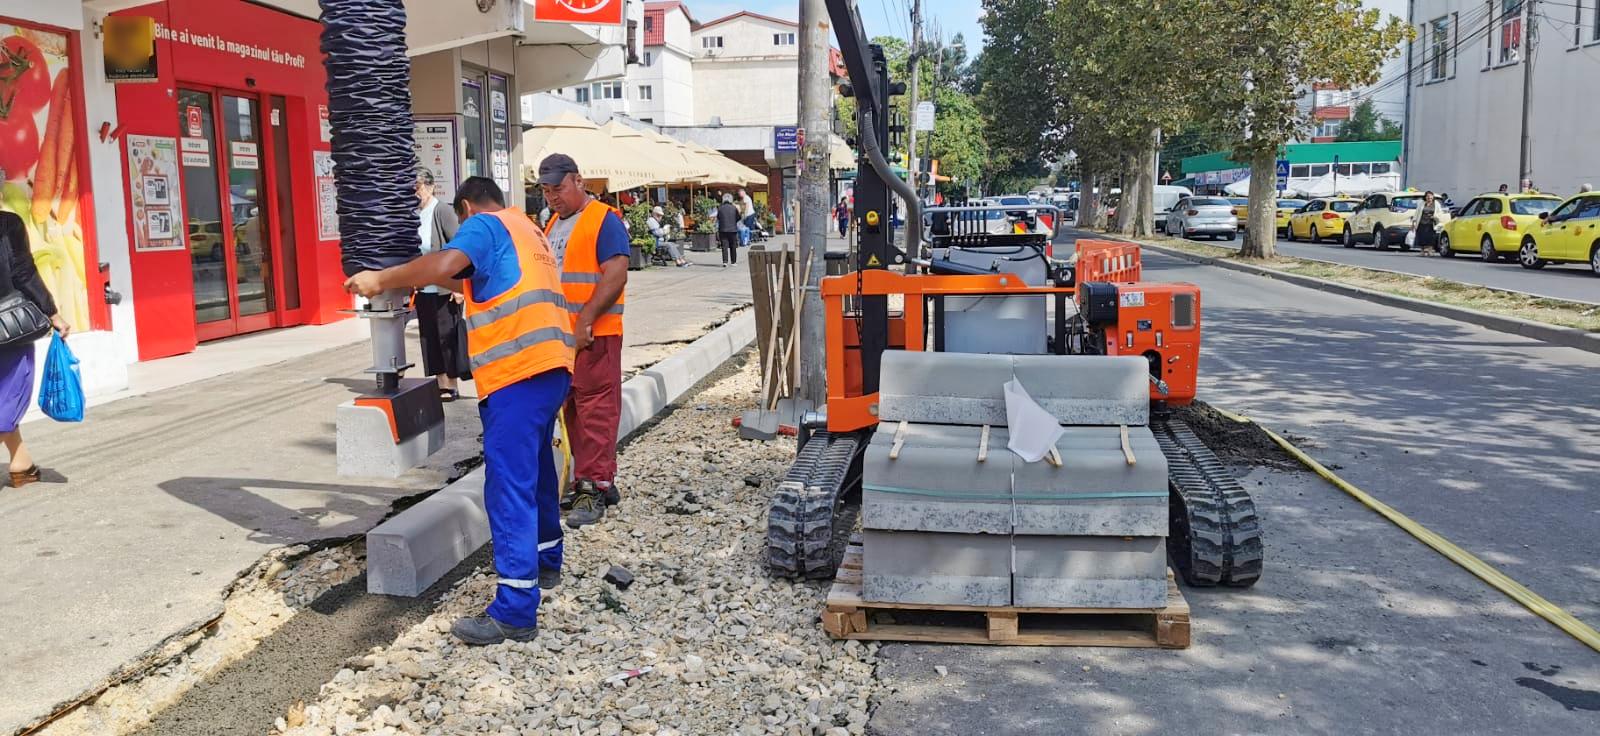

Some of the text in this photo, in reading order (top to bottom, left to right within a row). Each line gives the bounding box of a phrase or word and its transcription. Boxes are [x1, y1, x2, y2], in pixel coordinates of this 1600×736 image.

[155, 23, 177, 41] Bine
[179, 28, 189, 43] ai
[190, 34, 215, 49] venit
[216, 35, 225, 51] la
[226, 41, 270, 61] magazinul
[284, 52, 305, 69] Profi!
